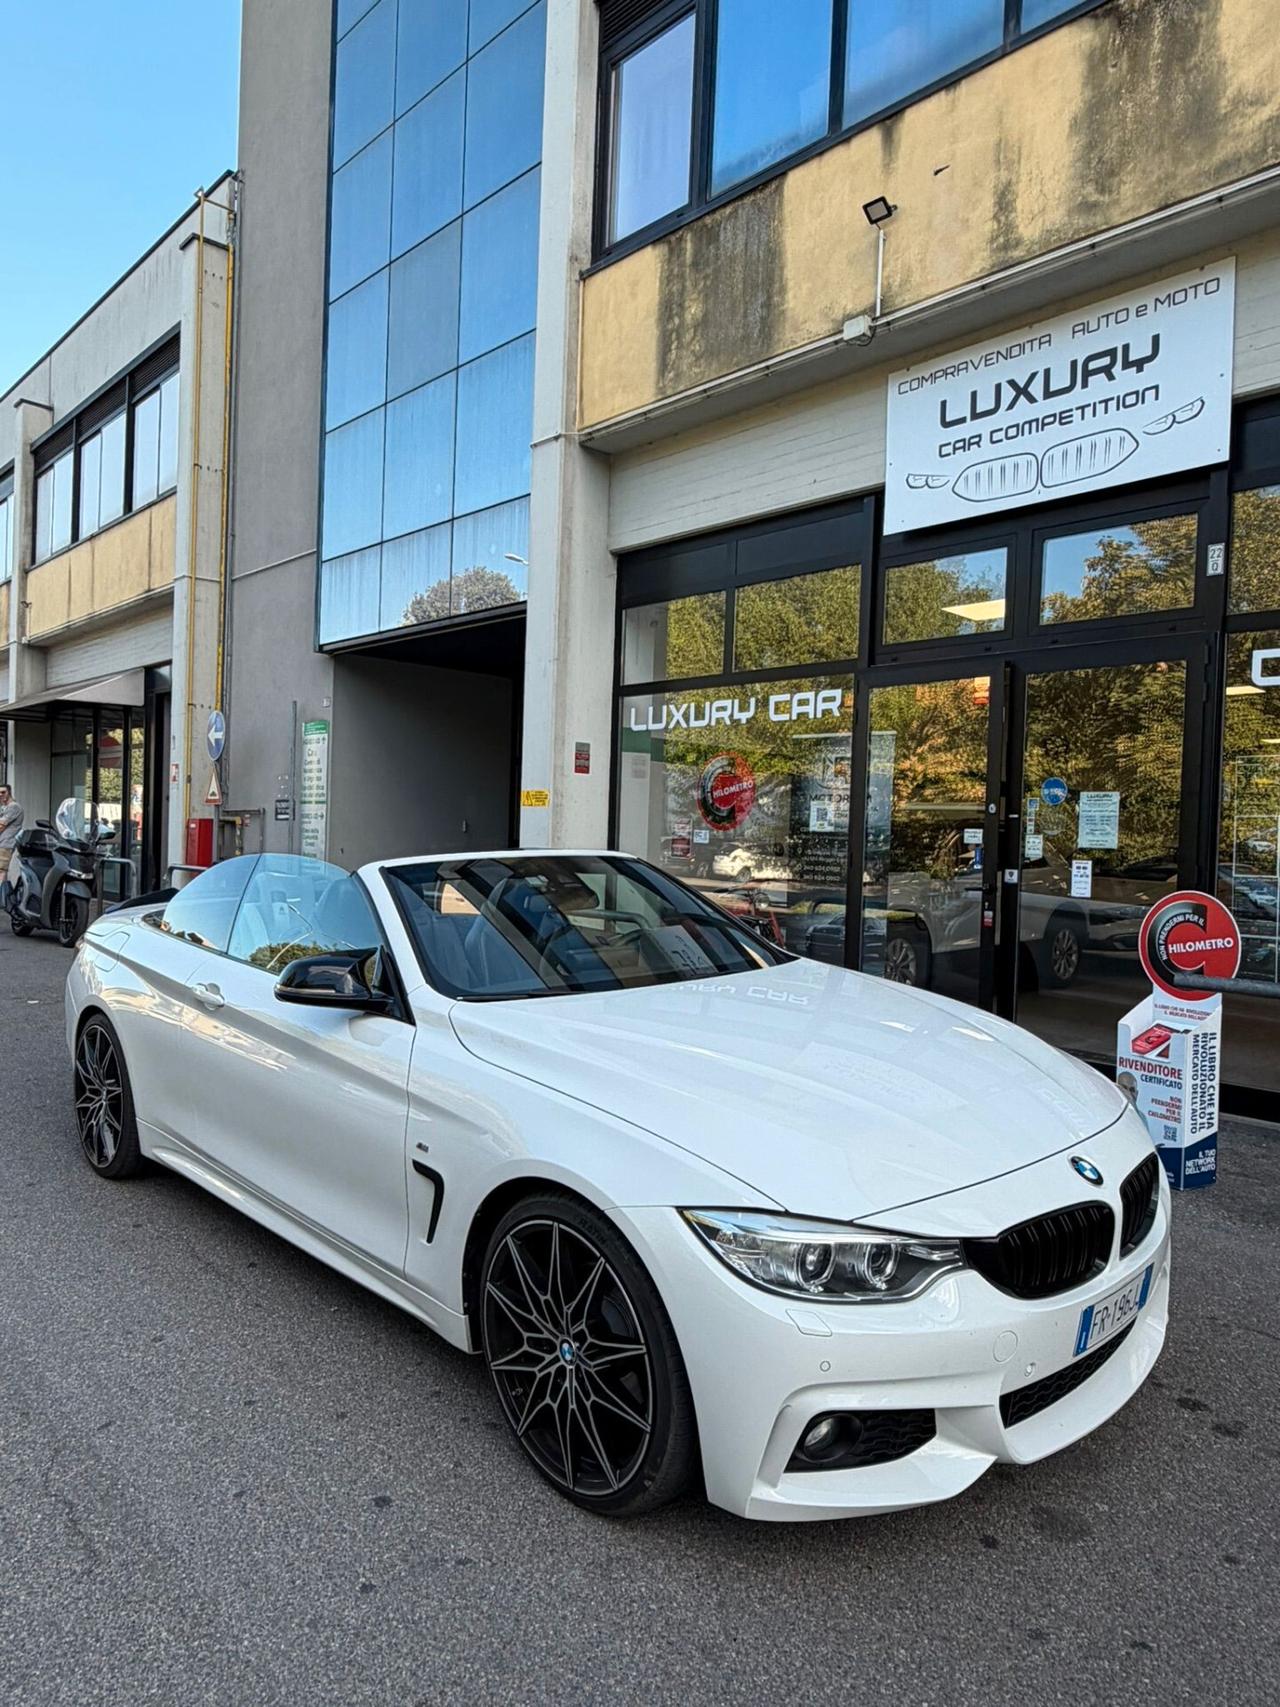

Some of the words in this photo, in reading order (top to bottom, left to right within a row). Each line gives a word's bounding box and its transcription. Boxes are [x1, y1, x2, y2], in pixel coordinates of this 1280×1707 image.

[897, 333, 1052, 395] COMPRAVENDITA
[1071, 307, 1130, 339] AUTO
[1135, 303, 1148, 318] e
[1154, 277, 1220, 312] MOTO
[939, 333, 1160, 429] LUXURY
[938, 433, 983, 459] CAR
[989, 384, 1160, 445] COMPETITION
[1210, 547, 1222, 559] 22
[630, 697, 756, 732] LUXURY
[768, 688, 843, 722] CAR
[1208, 1032, 1217, 1043] IL
[1118, 1056, 1183, 1080] RIVENDITORE
[1191, 1034, 1200, 1081] MERCATO
[1207, 1046, 1216, 1081] LIBRO
[1140, 1073, 1183, 1090] CERTIFICATO
[1198, 1032, 1208, 1119] RIVOLUZIONATO
[1190, 1083, 1199, 1134] DELL'AUTO
[1206, 1085, 1216, 1109] CHE
[1206, 1112, 1215, 1130] HA
[1185, 1157, 1216, 1167] NETWORK
